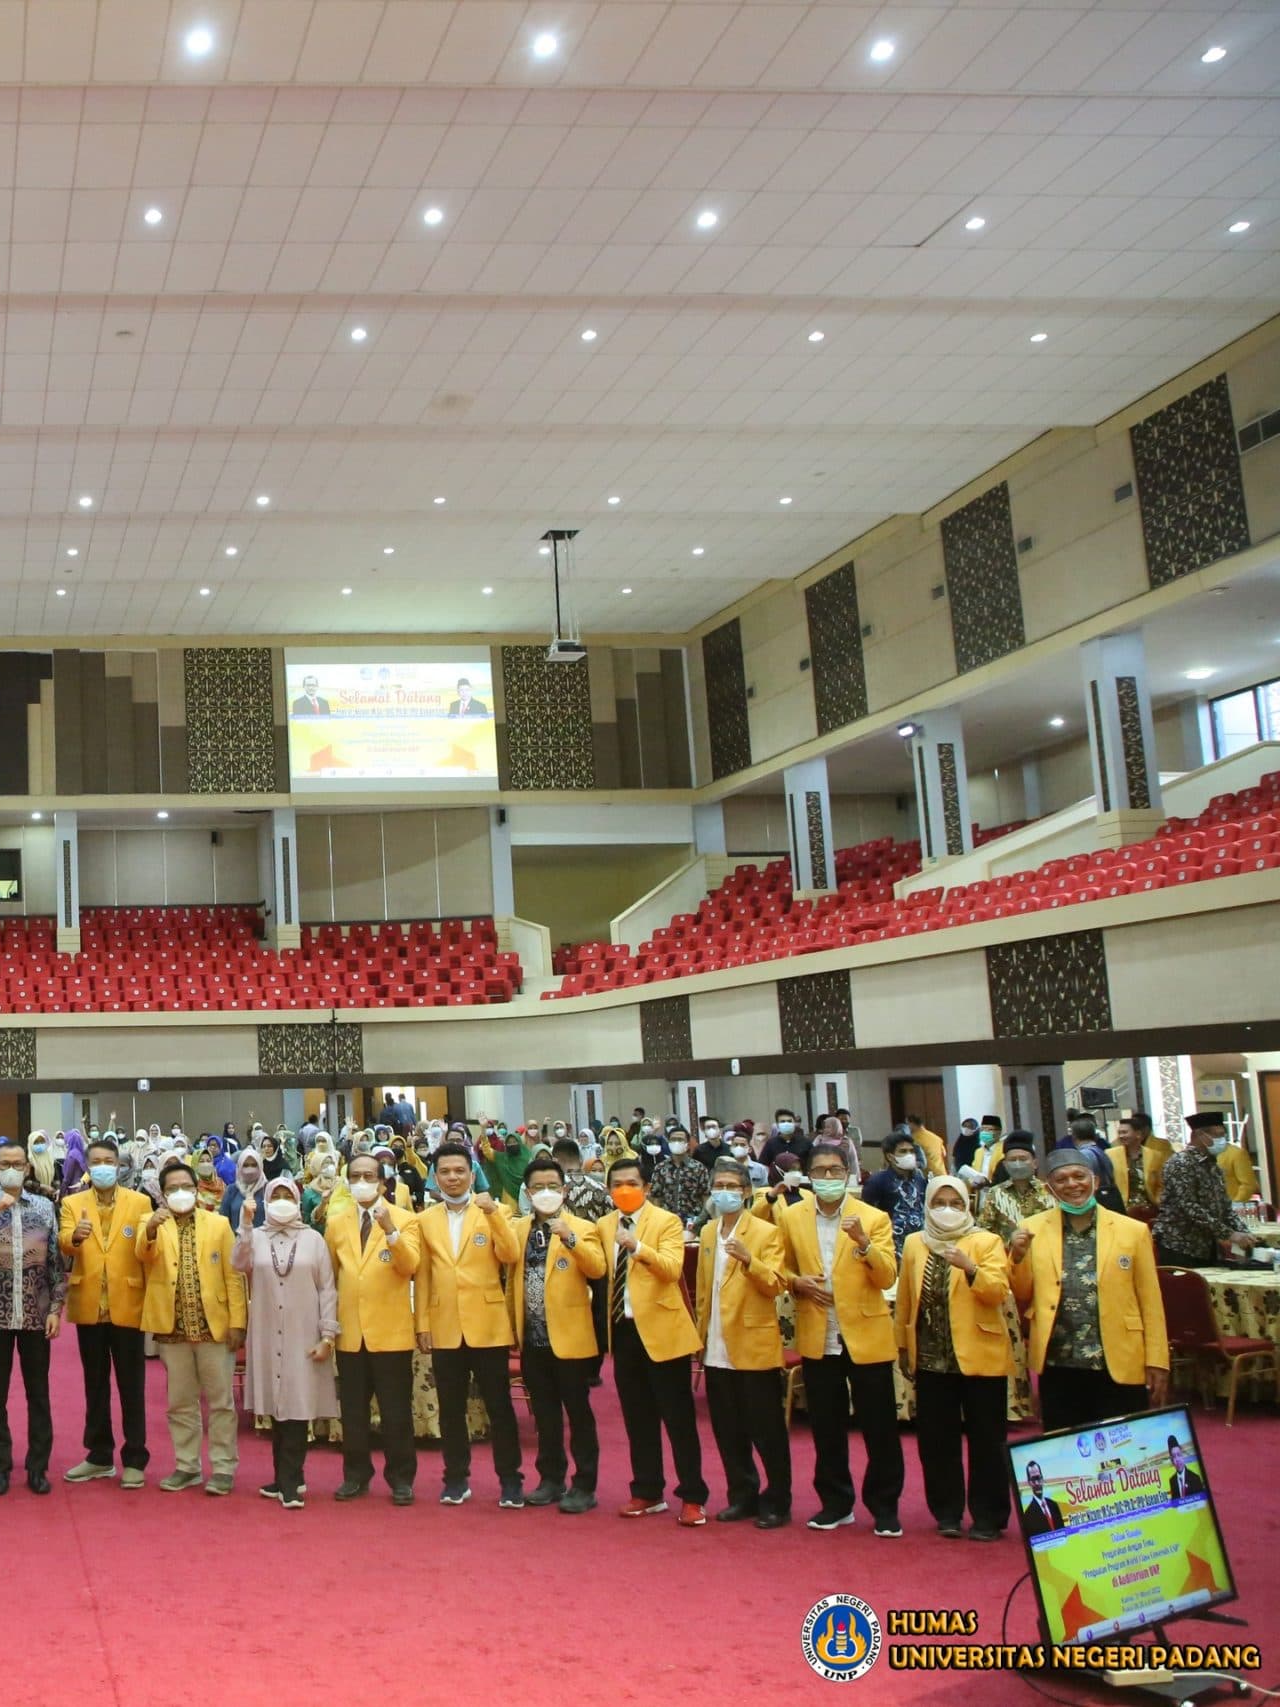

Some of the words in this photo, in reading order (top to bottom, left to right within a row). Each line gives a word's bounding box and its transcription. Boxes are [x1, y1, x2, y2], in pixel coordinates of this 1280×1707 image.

[339, 689, 390, 705] Selamat
[395, 688, 442, 705] Datang
[1066, 1473, 1115, 1505] Selamat
[1116, 1467, 1162, 1492] Datang
